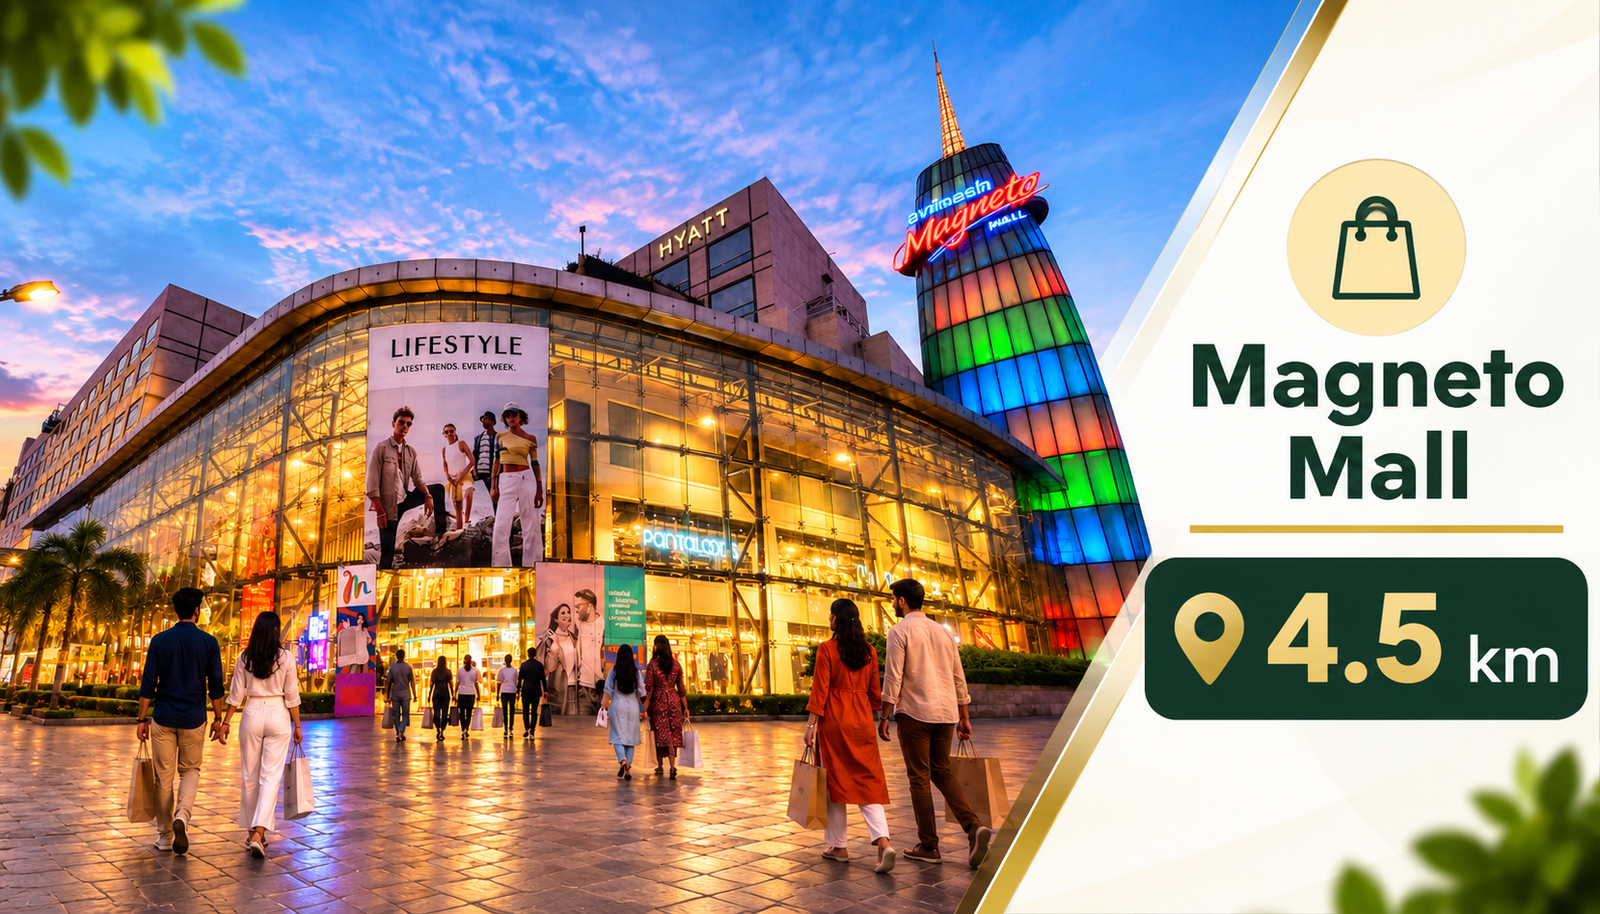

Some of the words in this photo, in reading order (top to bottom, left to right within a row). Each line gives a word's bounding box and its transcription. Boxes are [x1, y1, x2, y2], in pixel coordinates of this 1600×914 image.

[659, 207, 729, 259] HYATT
[893, 171, 1041, 271] Magneto
[391, 335, 522, 358] LIFESTYLE
[395, 363, 423, 374] LATEST
[426, 363, 460, 371] TRENDS.
[462, 362, 488, 371] EVERY
[490, 363, 517, 372] WEEK.
